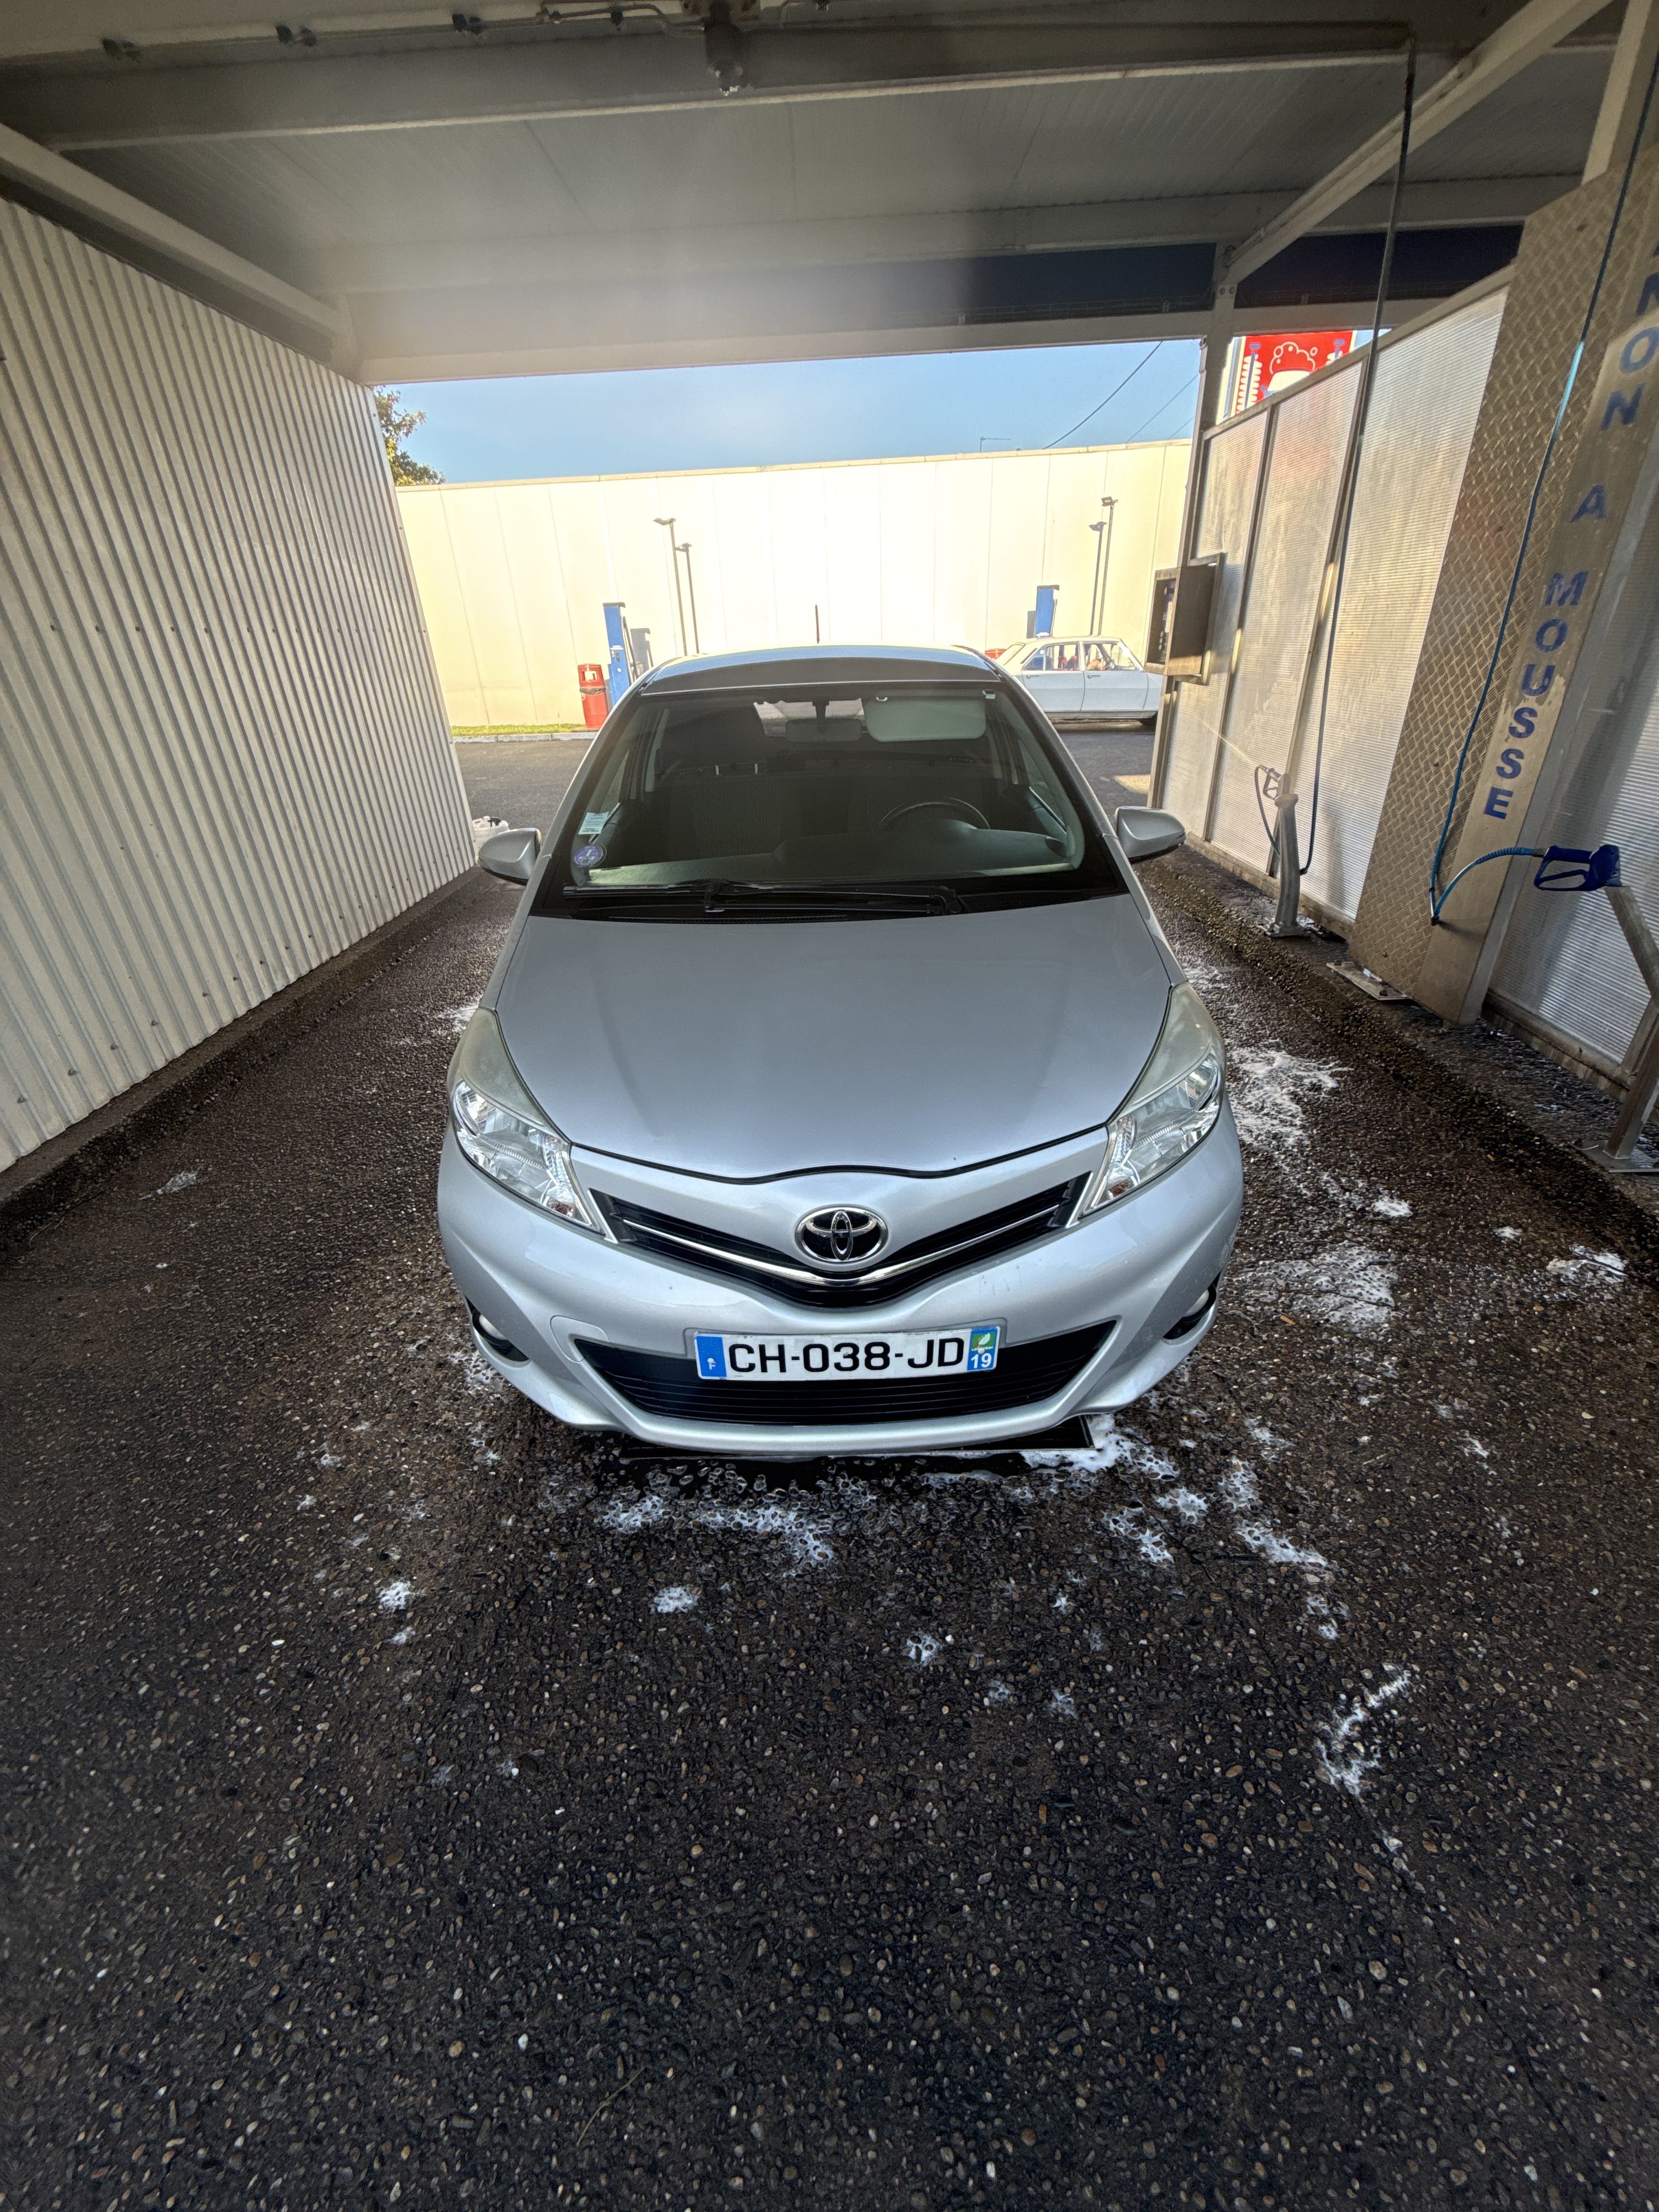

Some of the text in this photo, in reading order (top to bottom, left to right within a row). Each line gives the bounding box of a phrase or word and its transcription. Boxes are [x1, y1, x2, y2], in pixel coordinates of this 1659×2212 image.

[1570, 483, 1606, 523] A
[1483, 570, 1589, 821] MOUSSE
[729, 1338, 965, 1373] CH-038-JD
[970, 1352, 992, 1369] 19
